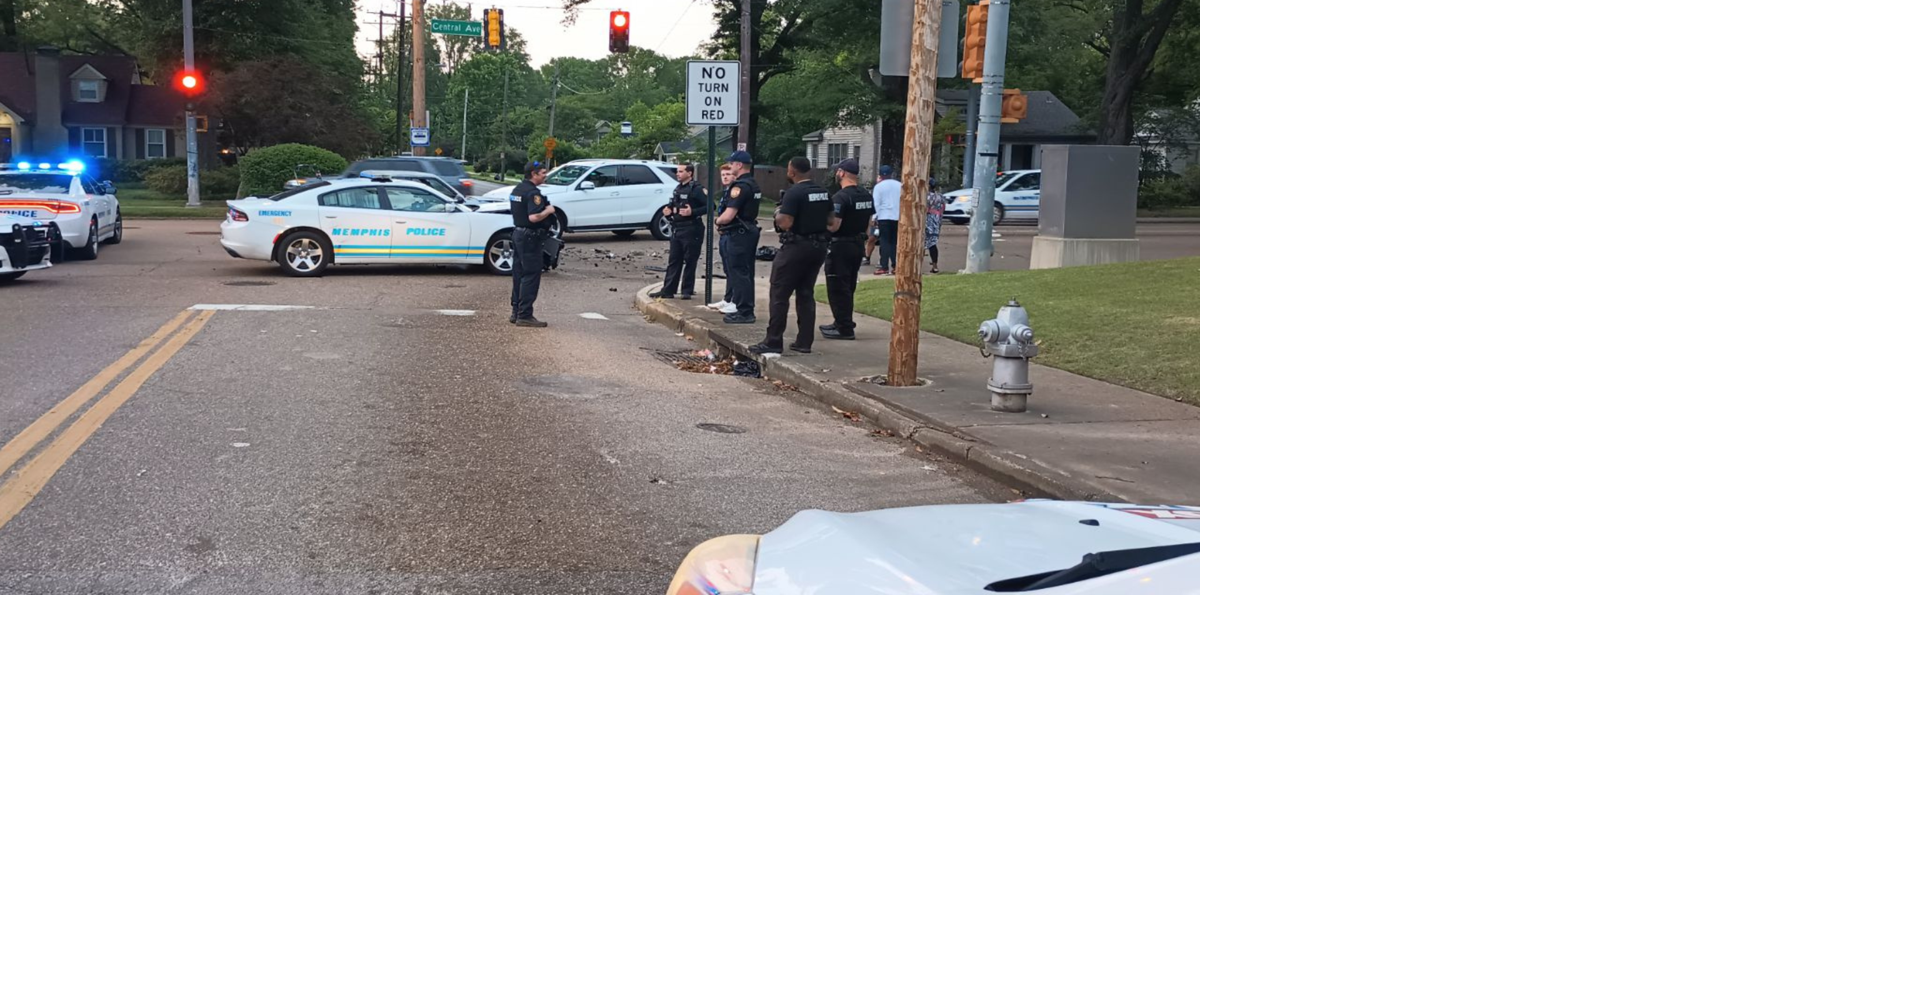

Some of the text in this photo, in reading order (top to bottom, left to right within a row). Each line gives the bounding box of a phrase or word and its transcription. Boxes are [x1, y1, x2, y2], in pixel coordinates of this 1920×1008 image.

[432, 22, 481, 33] Central Ave
[702, 67, 726, 79] NO
[698, 83, 729, 93] TURN
[704, 96, 722, 107] ON
[701, 109, 725, 120] RED
[0, 210, 37, 218] ICE
[331, 227, 446, 236] MEMPHIS POLICE
